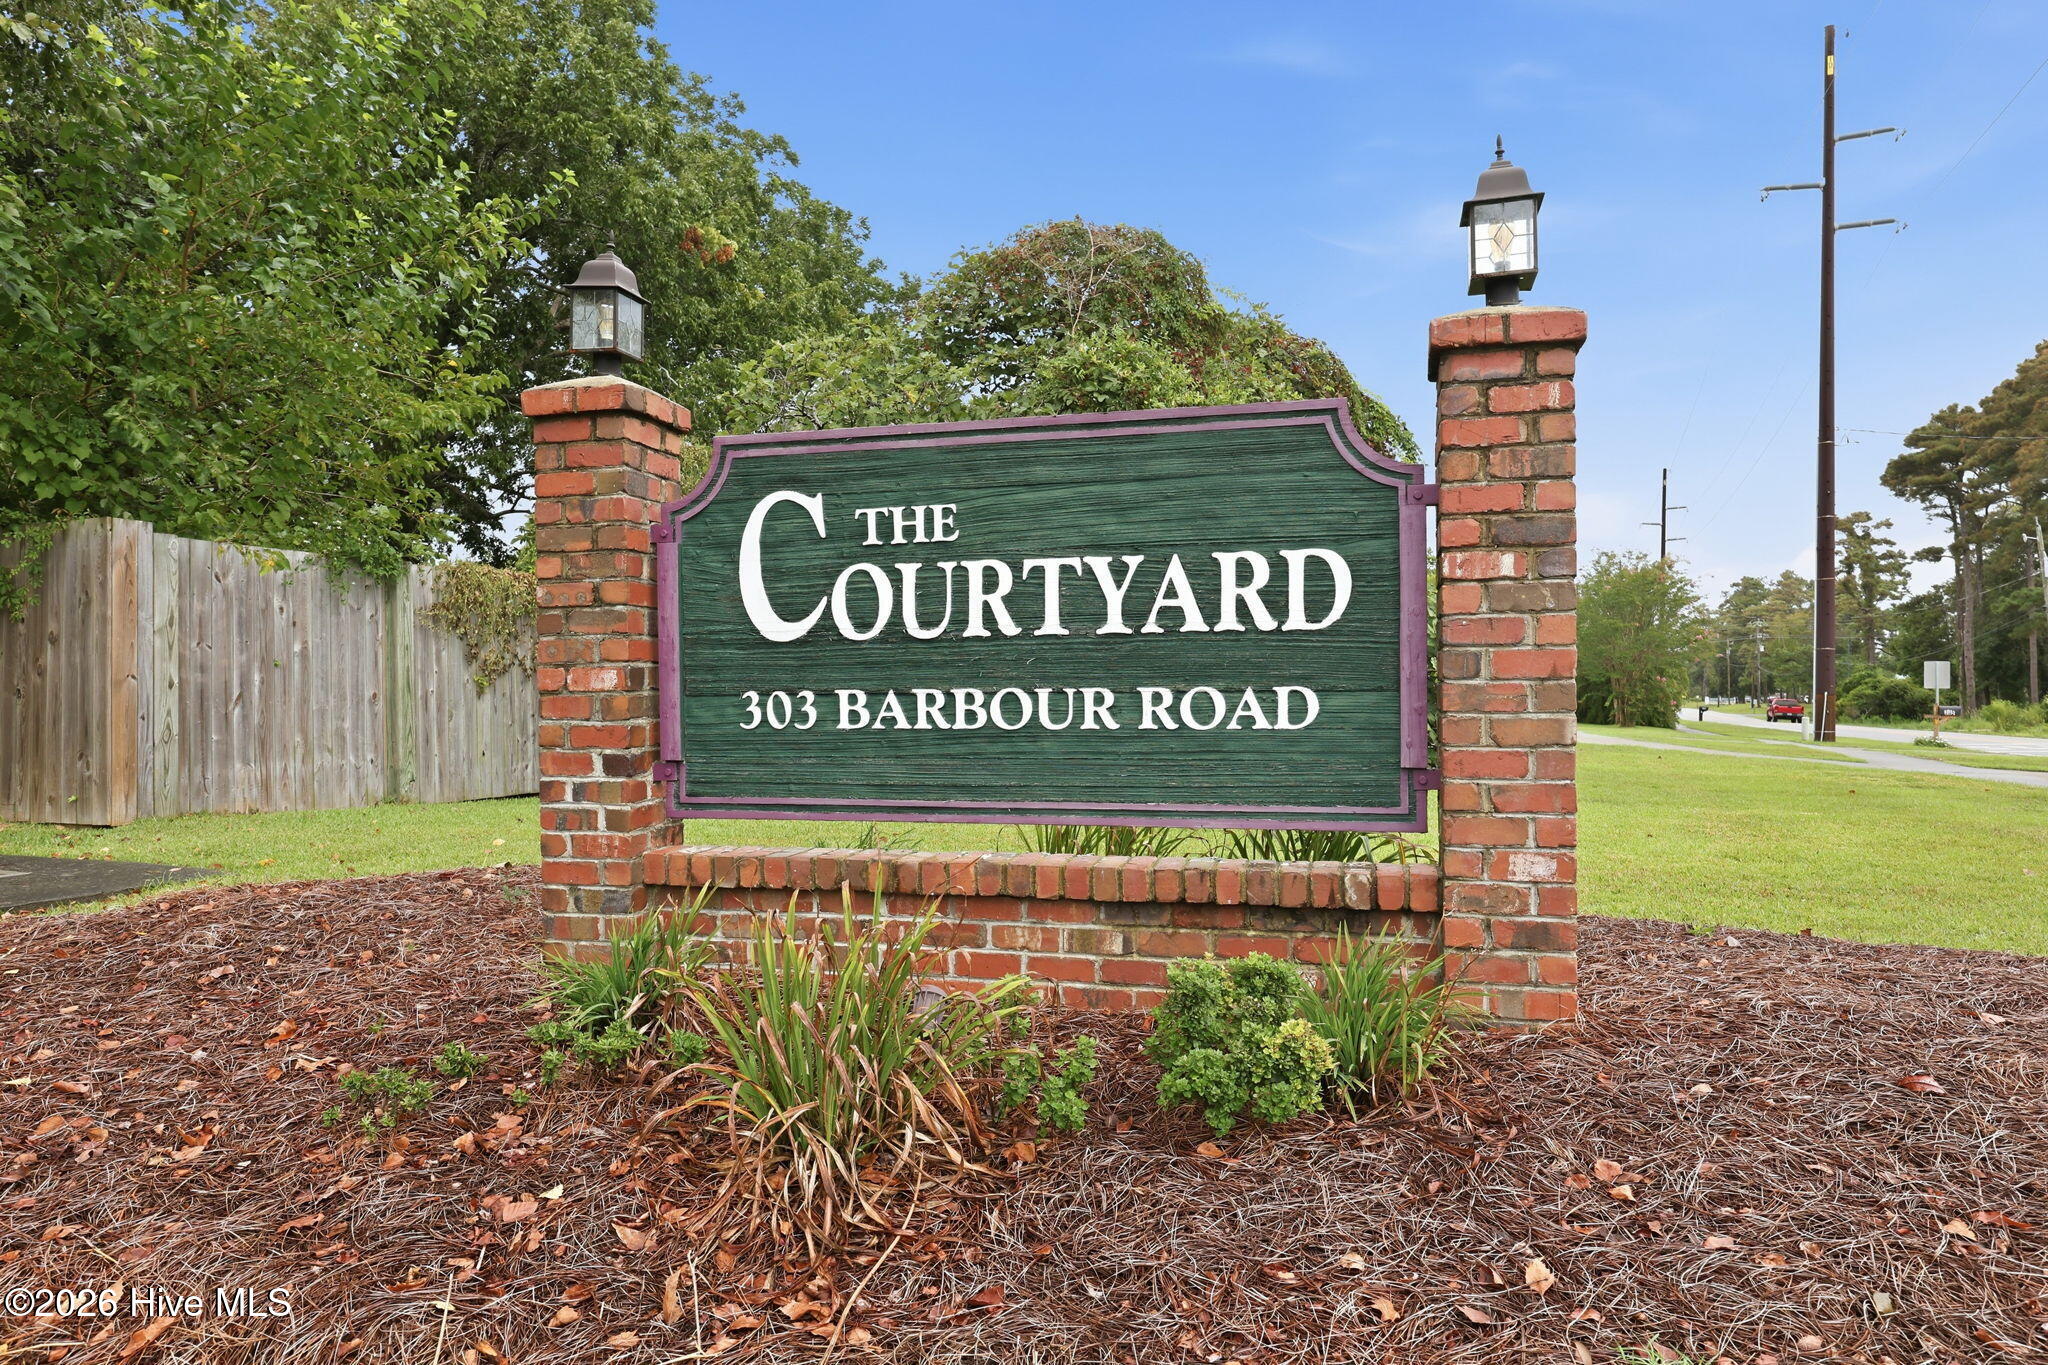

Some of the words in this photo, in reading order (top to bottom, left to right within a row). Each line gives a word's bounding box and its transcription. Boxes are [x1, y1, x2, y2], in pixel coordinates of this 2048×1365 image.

[855, 504, 960, 546] THE
[739, 489, 1353, 642] COURTYARD
[740, 690, 818, 730] 303
[834, 687, 1121, 731] BARBOUR
[1137, 685, 1321, 731] ROAD
